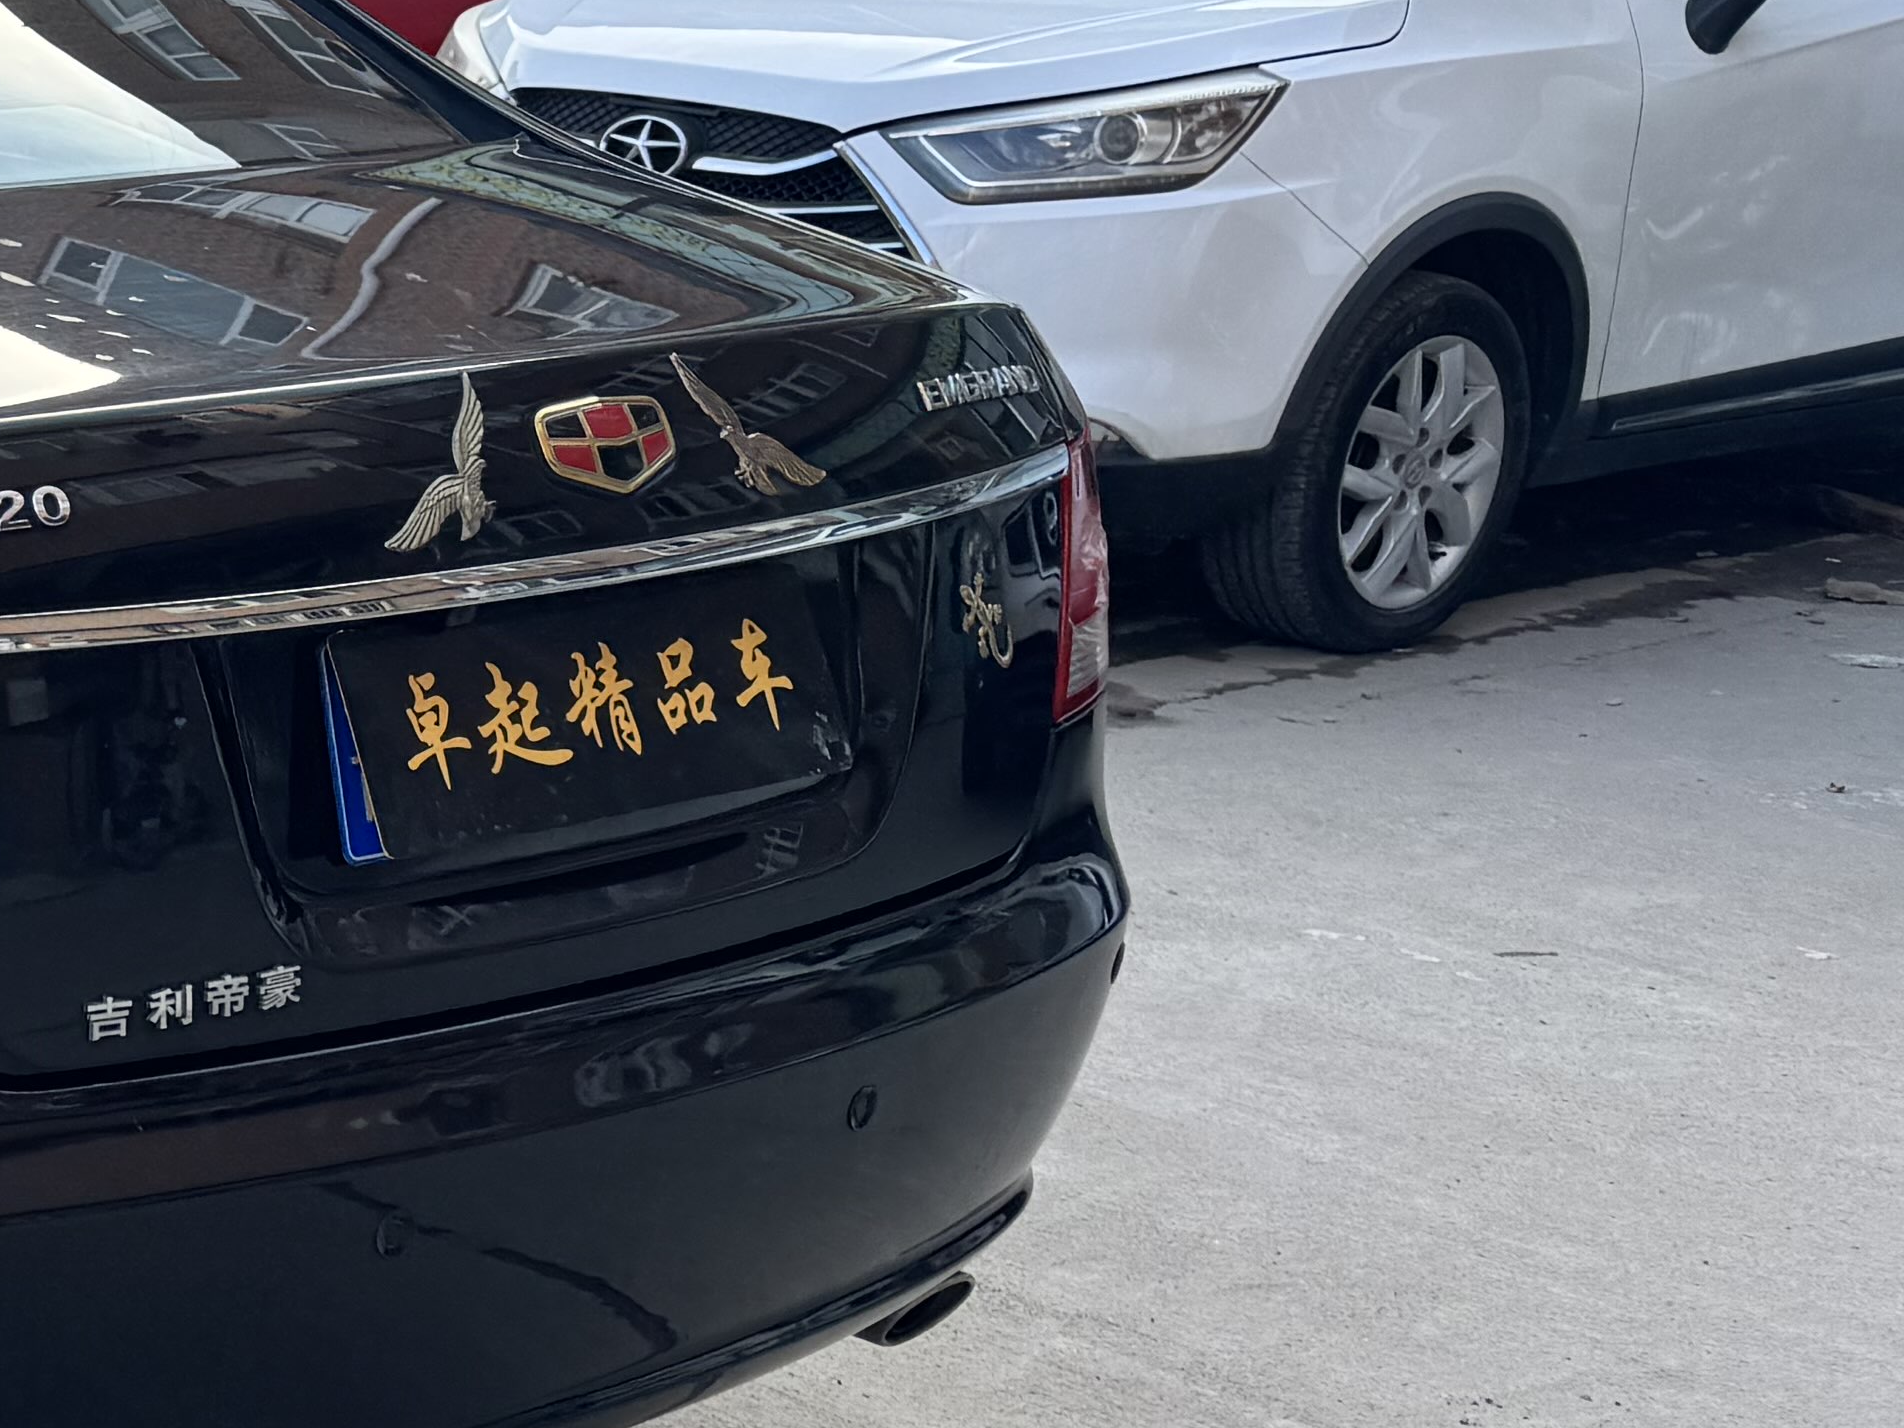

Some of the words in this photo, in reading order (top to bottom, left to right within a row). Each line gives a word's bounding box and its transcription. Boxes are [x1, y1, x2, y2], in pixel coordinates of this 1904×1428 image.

[405, 617, 794, 791] 卓起精品车
[84, 965, 302, 1042] 吉利帝豪
